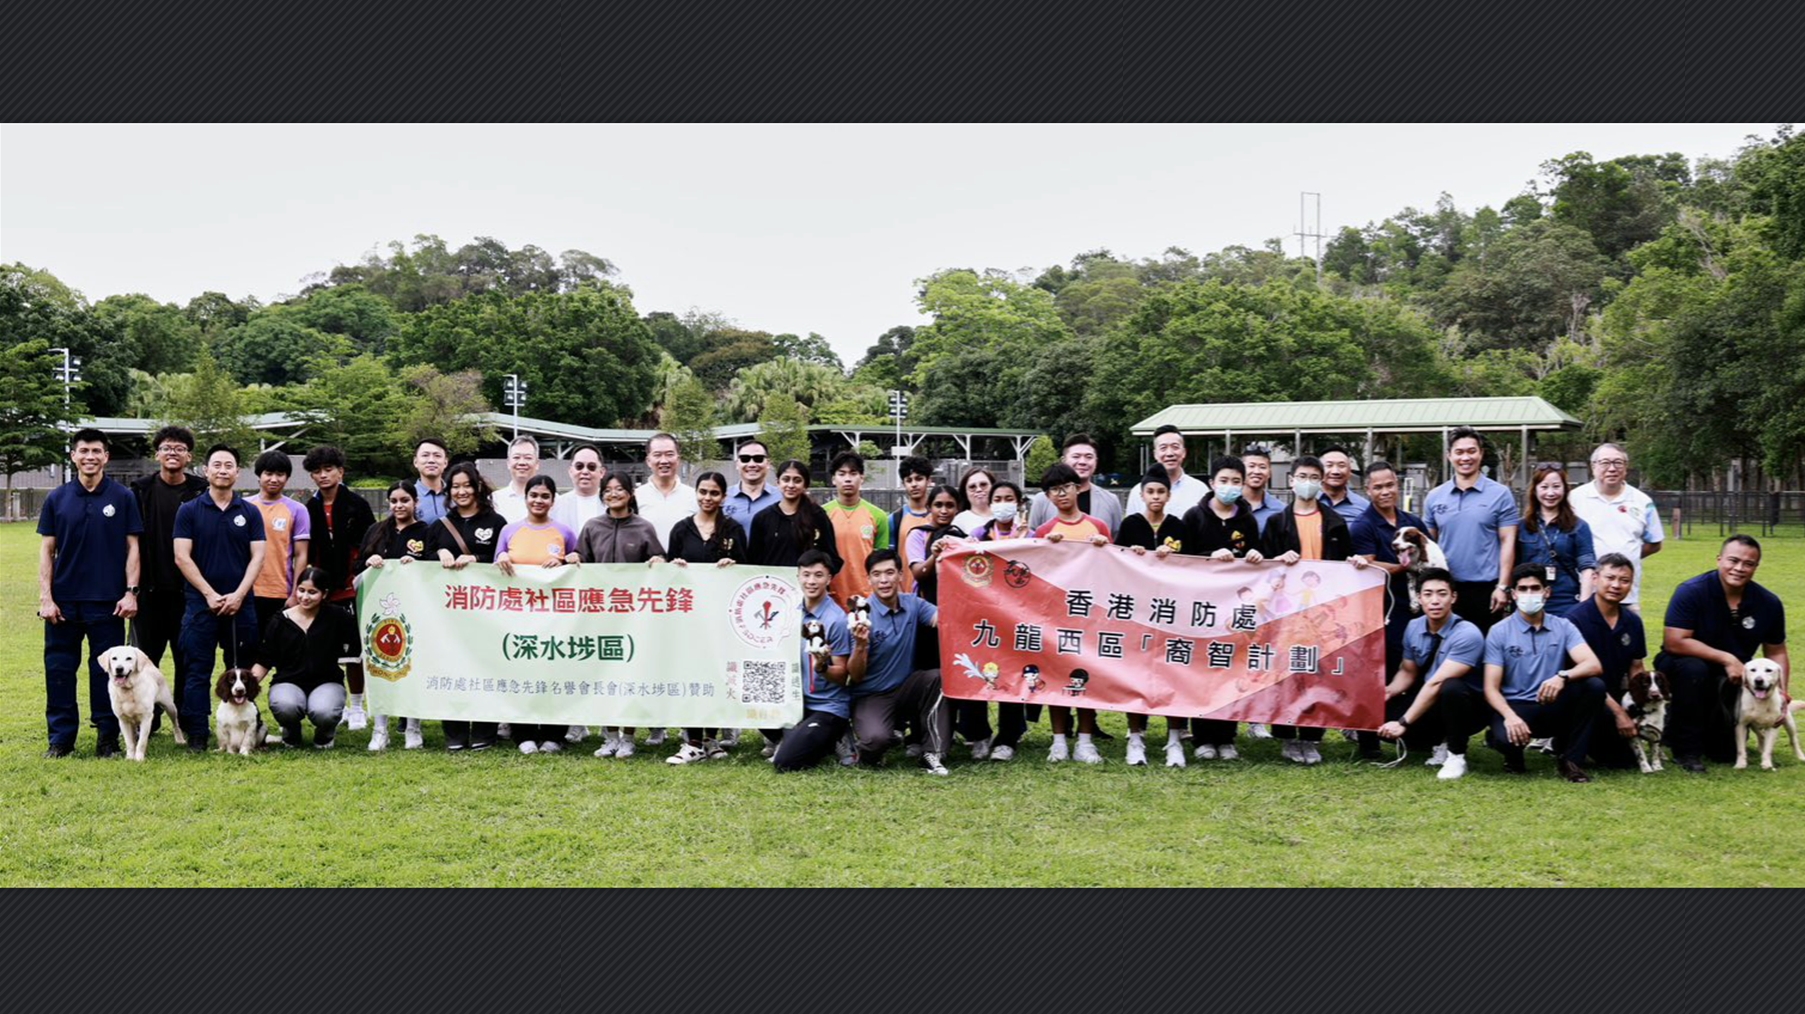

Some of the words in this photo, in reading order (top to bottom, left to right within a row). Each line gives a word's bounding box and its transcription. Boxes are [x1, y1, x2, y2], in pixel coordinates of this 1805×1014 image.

[444, 584, 694, 614] 消防處社區應急先鋒
[1064, 589, 1258, 632] 香港消防處
[502, 632, 635, 662] (深水埗區)
[971, 620, 1345, 676] 九龍西區「裔智計劃」
